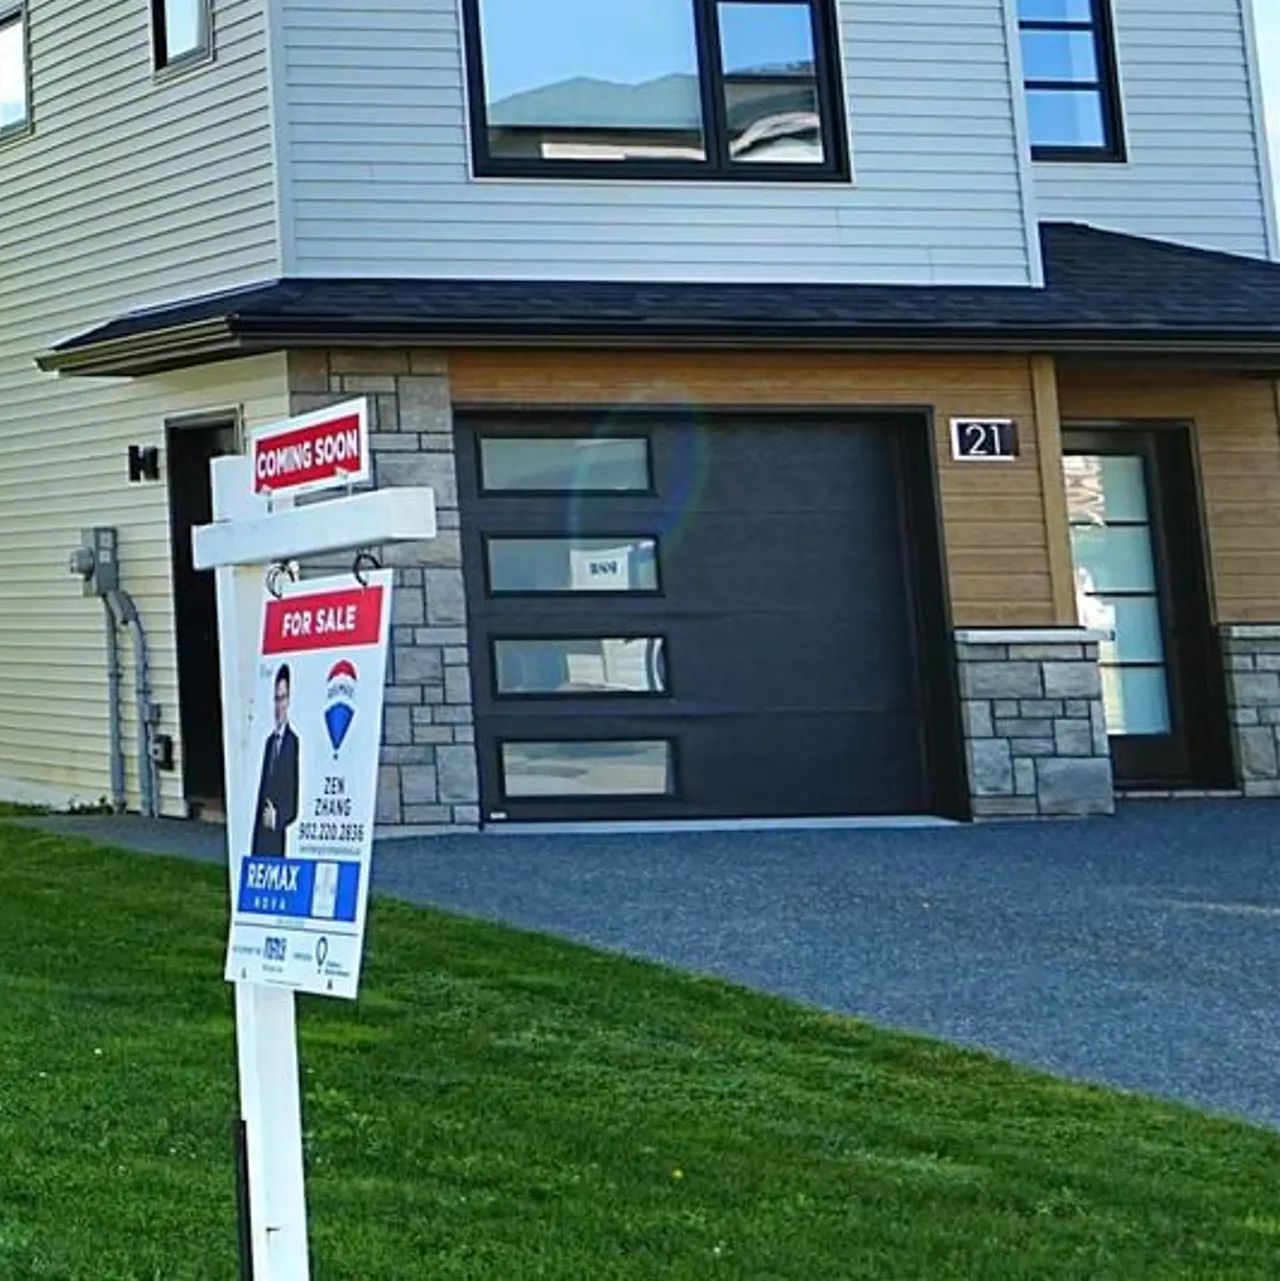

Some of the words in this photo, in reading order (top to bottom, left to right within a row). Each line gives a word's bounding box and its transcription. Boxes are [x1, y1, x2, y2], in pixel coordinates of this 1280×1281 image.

[256, 439, 312, 478] COMING
[314, 428, 359, 466] SOON
[965, 424, 1001, 455] 21
[281, 612, 311, 637] FOR
[315, 605, 357, 634] SALE
[324, 776, 346, 795] ZEN
[314, 797, 353, 817] ZHANG
[247, 862, 301, 892] RE/MAX
